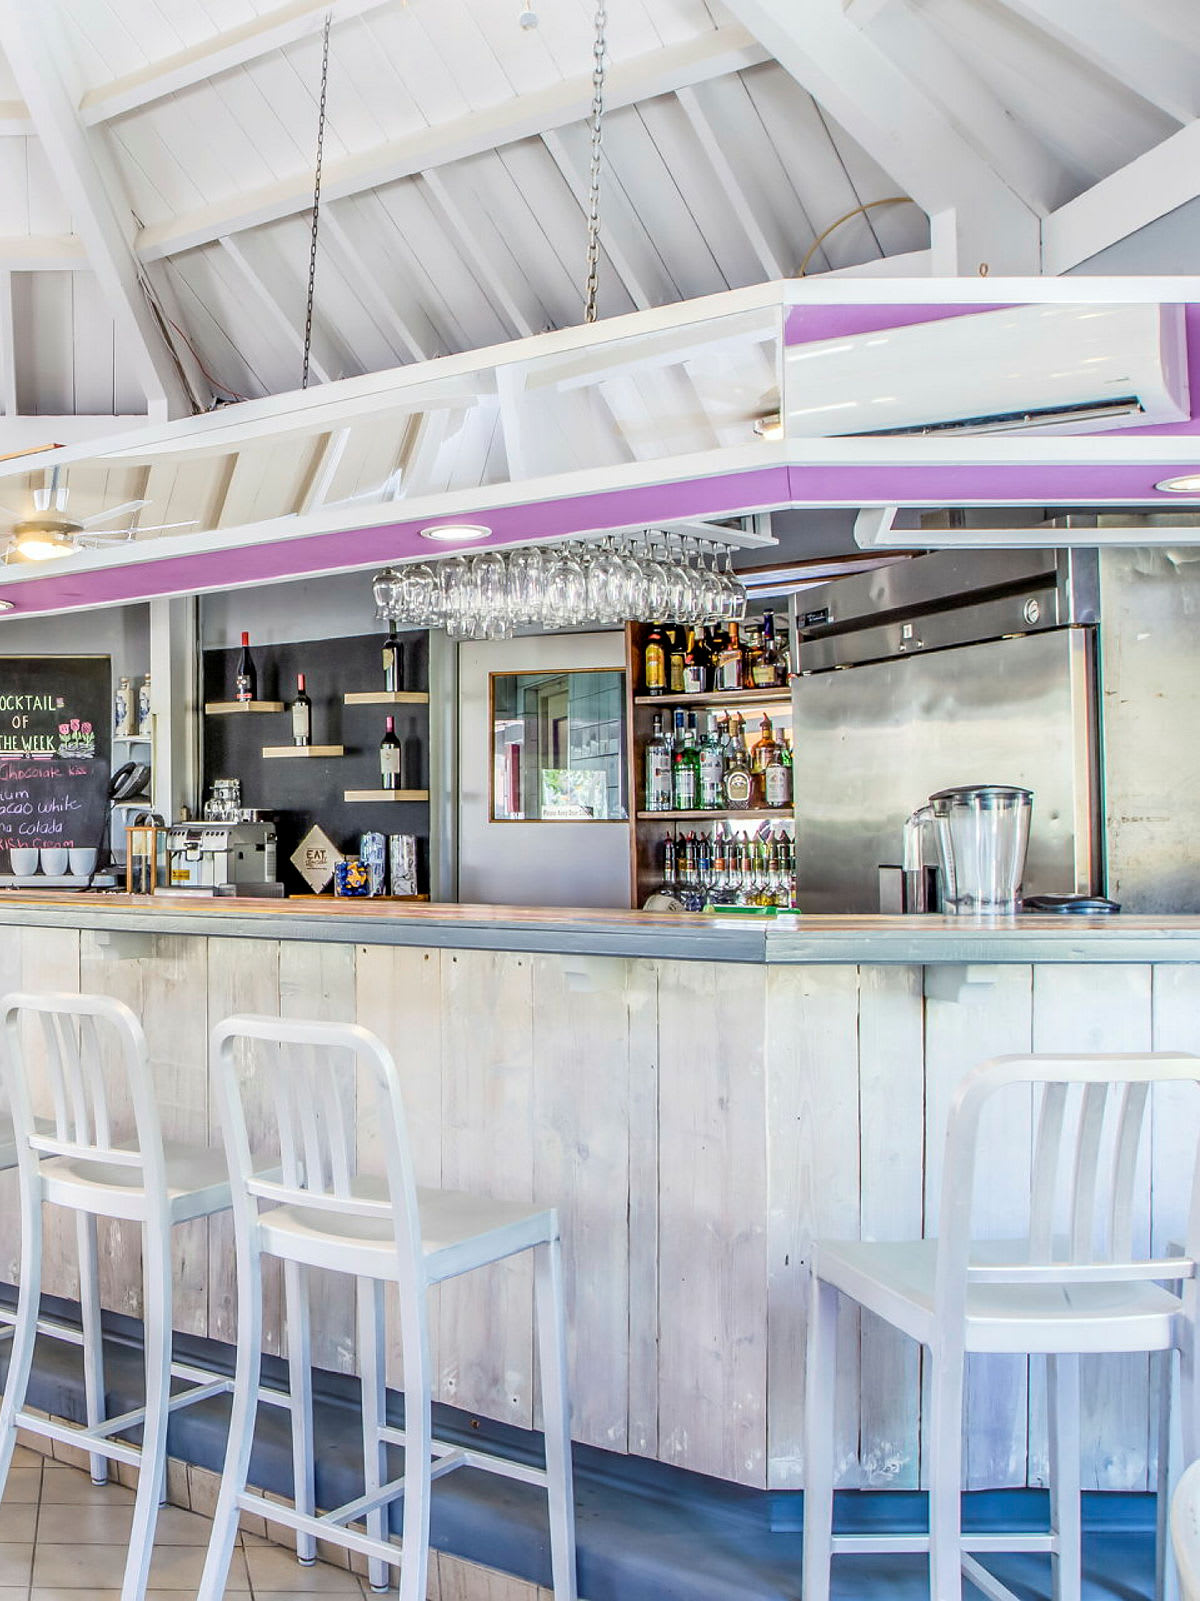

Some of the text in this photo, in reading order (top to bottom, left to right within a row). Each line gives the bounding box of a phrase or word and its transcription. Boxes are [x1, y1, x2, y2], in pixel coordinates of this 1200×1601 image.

[12, 715, 29, 729] OF
[21, 735, 55, 750] WEEK
[306, 849, 326, 860] EAT
